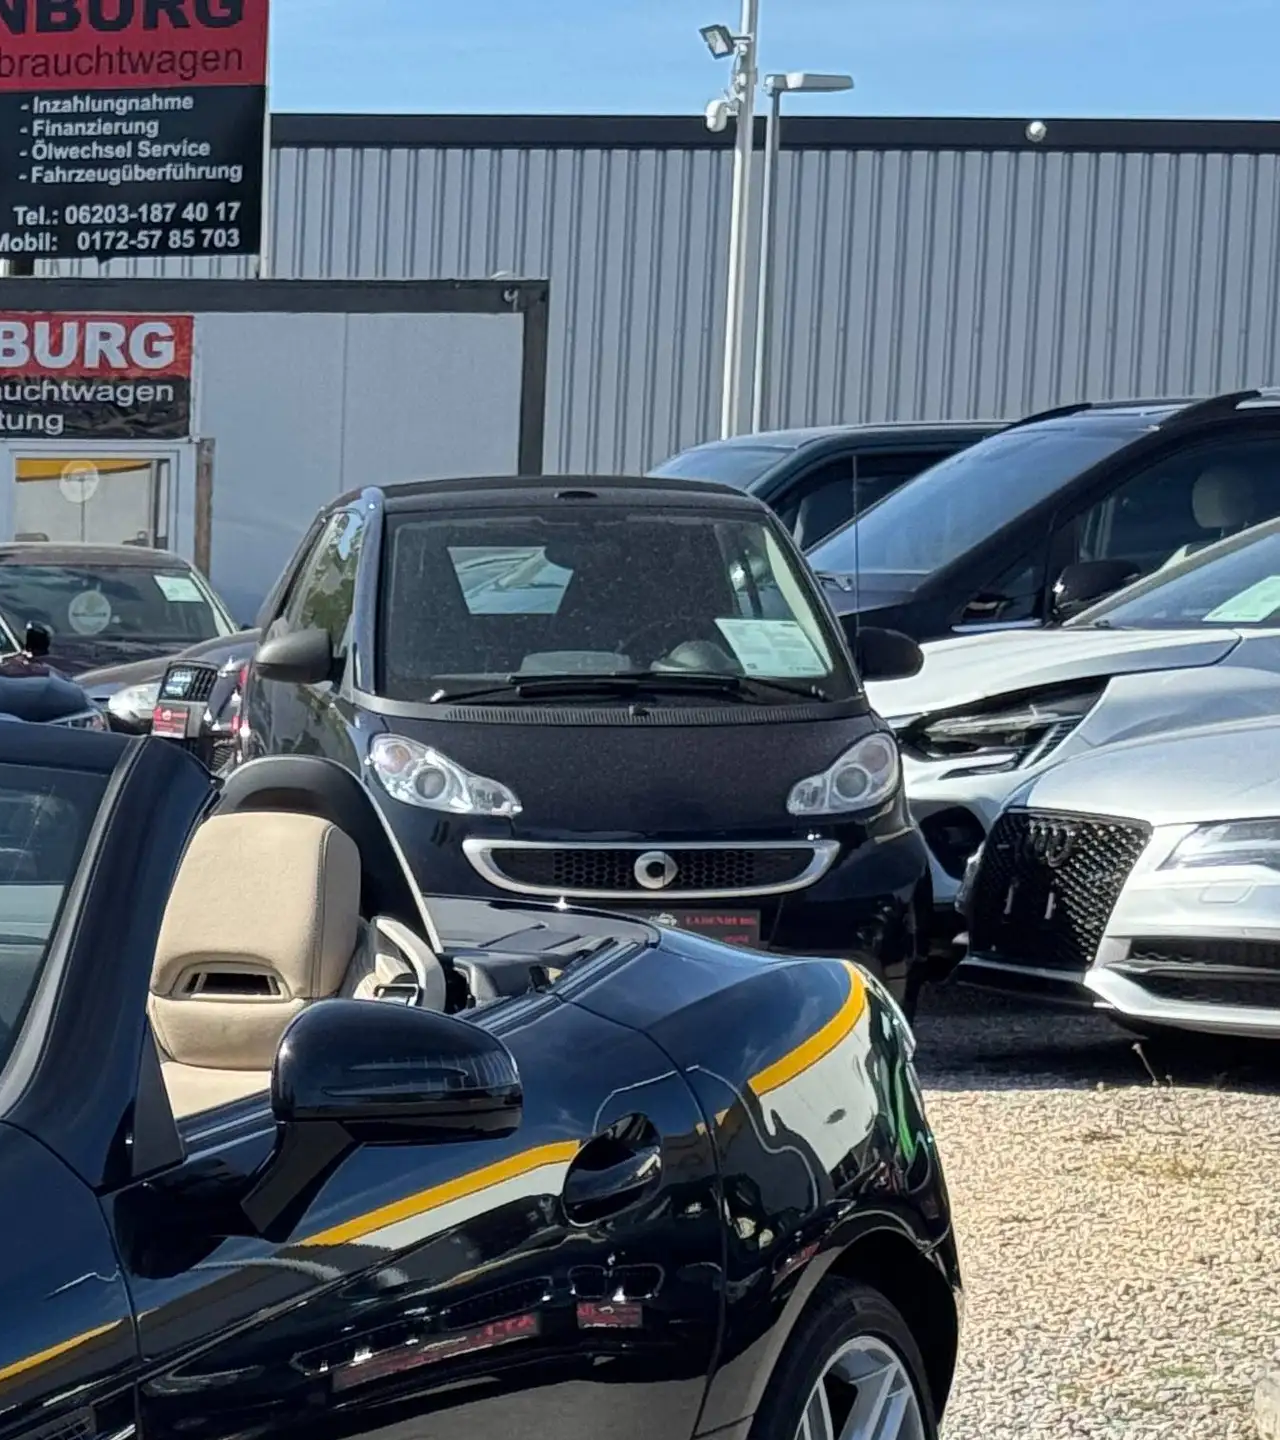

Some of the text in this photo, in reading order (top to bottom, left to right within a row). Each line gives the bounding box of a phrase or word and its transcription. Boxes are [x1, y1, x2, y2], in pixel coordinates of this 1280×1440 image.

[33, 93, 194, 116] Inzahlungnahme
[32, 117, 159, 138] Finanzierung
[31, 140, 132, 161] Ölwechsel
[138, 138, 211, 158] Service
[31, 161, 244, 186] Fahrzeugüberführung
[12, 202, 241, 226] Tel.: 06203-187 40 17
[77, 230, 162, 251] 0172-57
[168, 229, 195, 249] 85
[202, 228, 241, 249] 703
